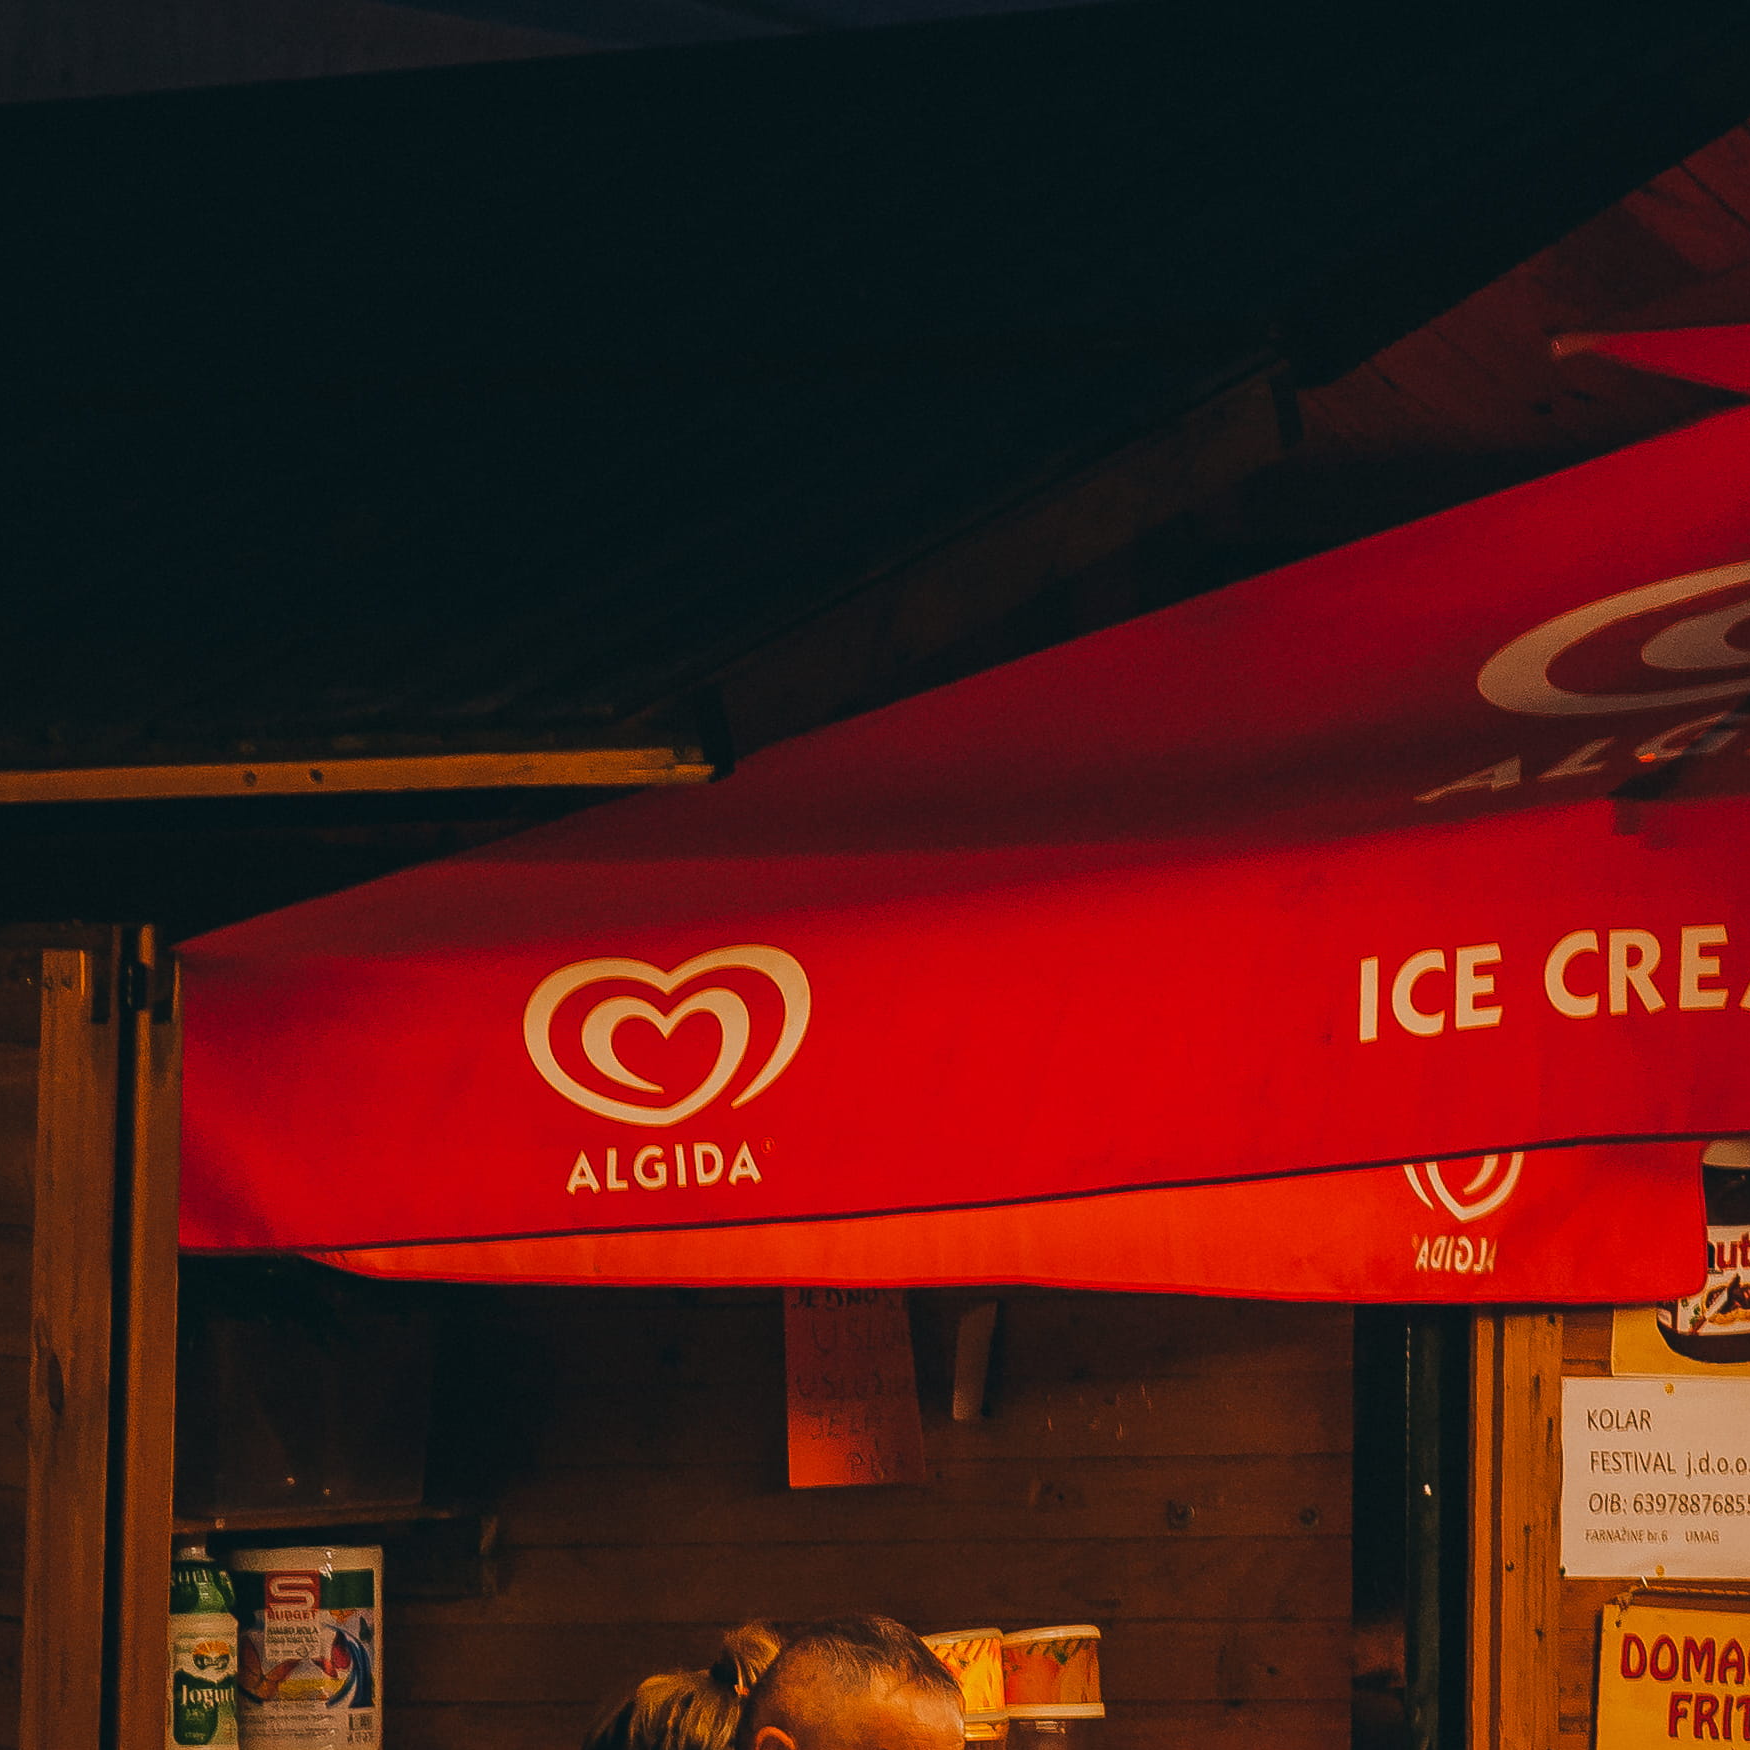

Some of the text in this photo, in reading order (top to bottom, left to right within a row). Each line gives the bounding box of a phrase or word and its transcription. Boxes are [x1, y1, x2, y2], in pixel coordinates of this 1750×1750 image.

[1358, 941, 1504, 1044] ICE
[565, 1141, 763, 1196] ALGIDA
[1586, 1408, 1652, 1431] KOLAR
[1590, 1450, 1677, 1474] FESTIVAL
[1588, 1492, 1628, 1515] OIB:
